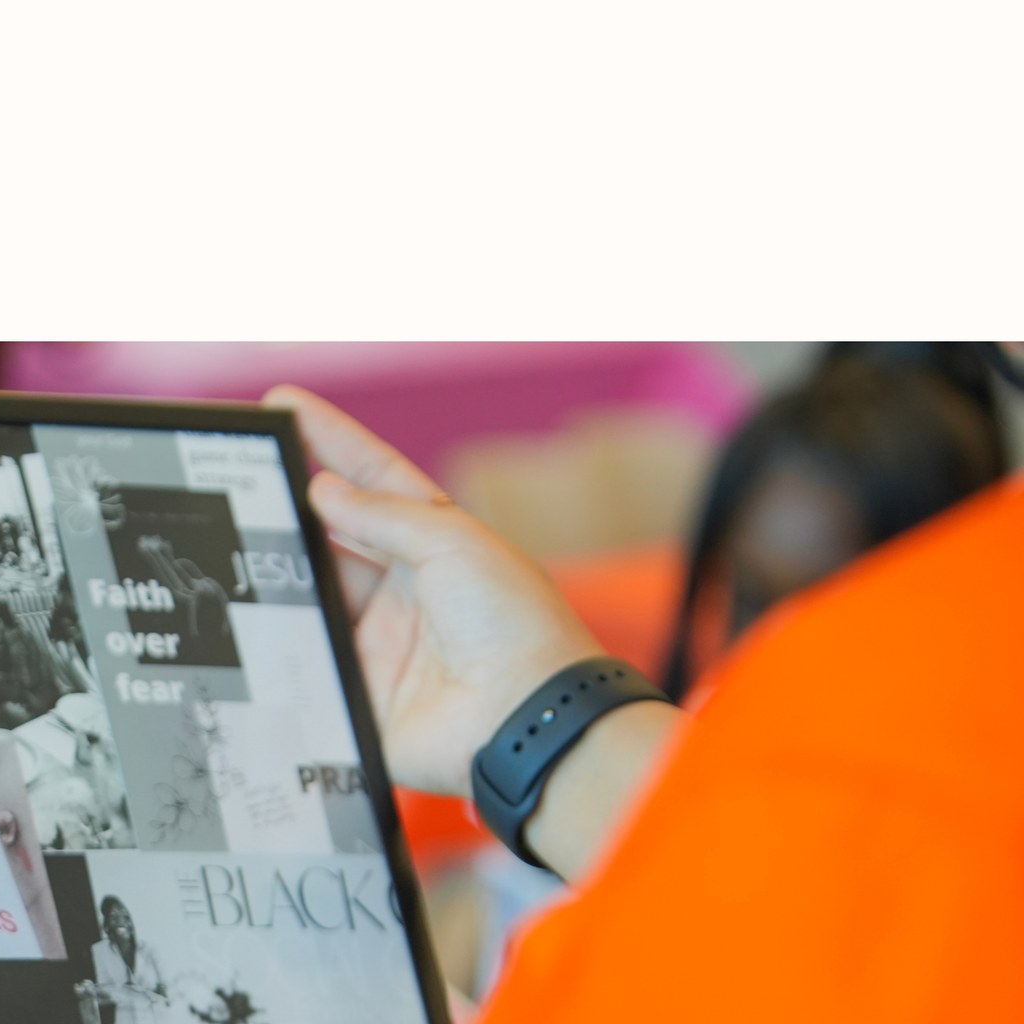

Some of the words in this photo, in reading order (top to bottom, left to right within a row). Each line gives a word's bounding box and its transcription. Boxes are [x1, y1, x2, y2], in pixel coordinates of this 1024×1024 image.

[231, 549, 314, 597] JESU
[87, 576, 175, 611] Faith
[104, 630, 180, 658] over
[114, 672, 185, 703] fear
[296, 764, 364, 795] PRA
[201, 864, 387, 932] BLACK
